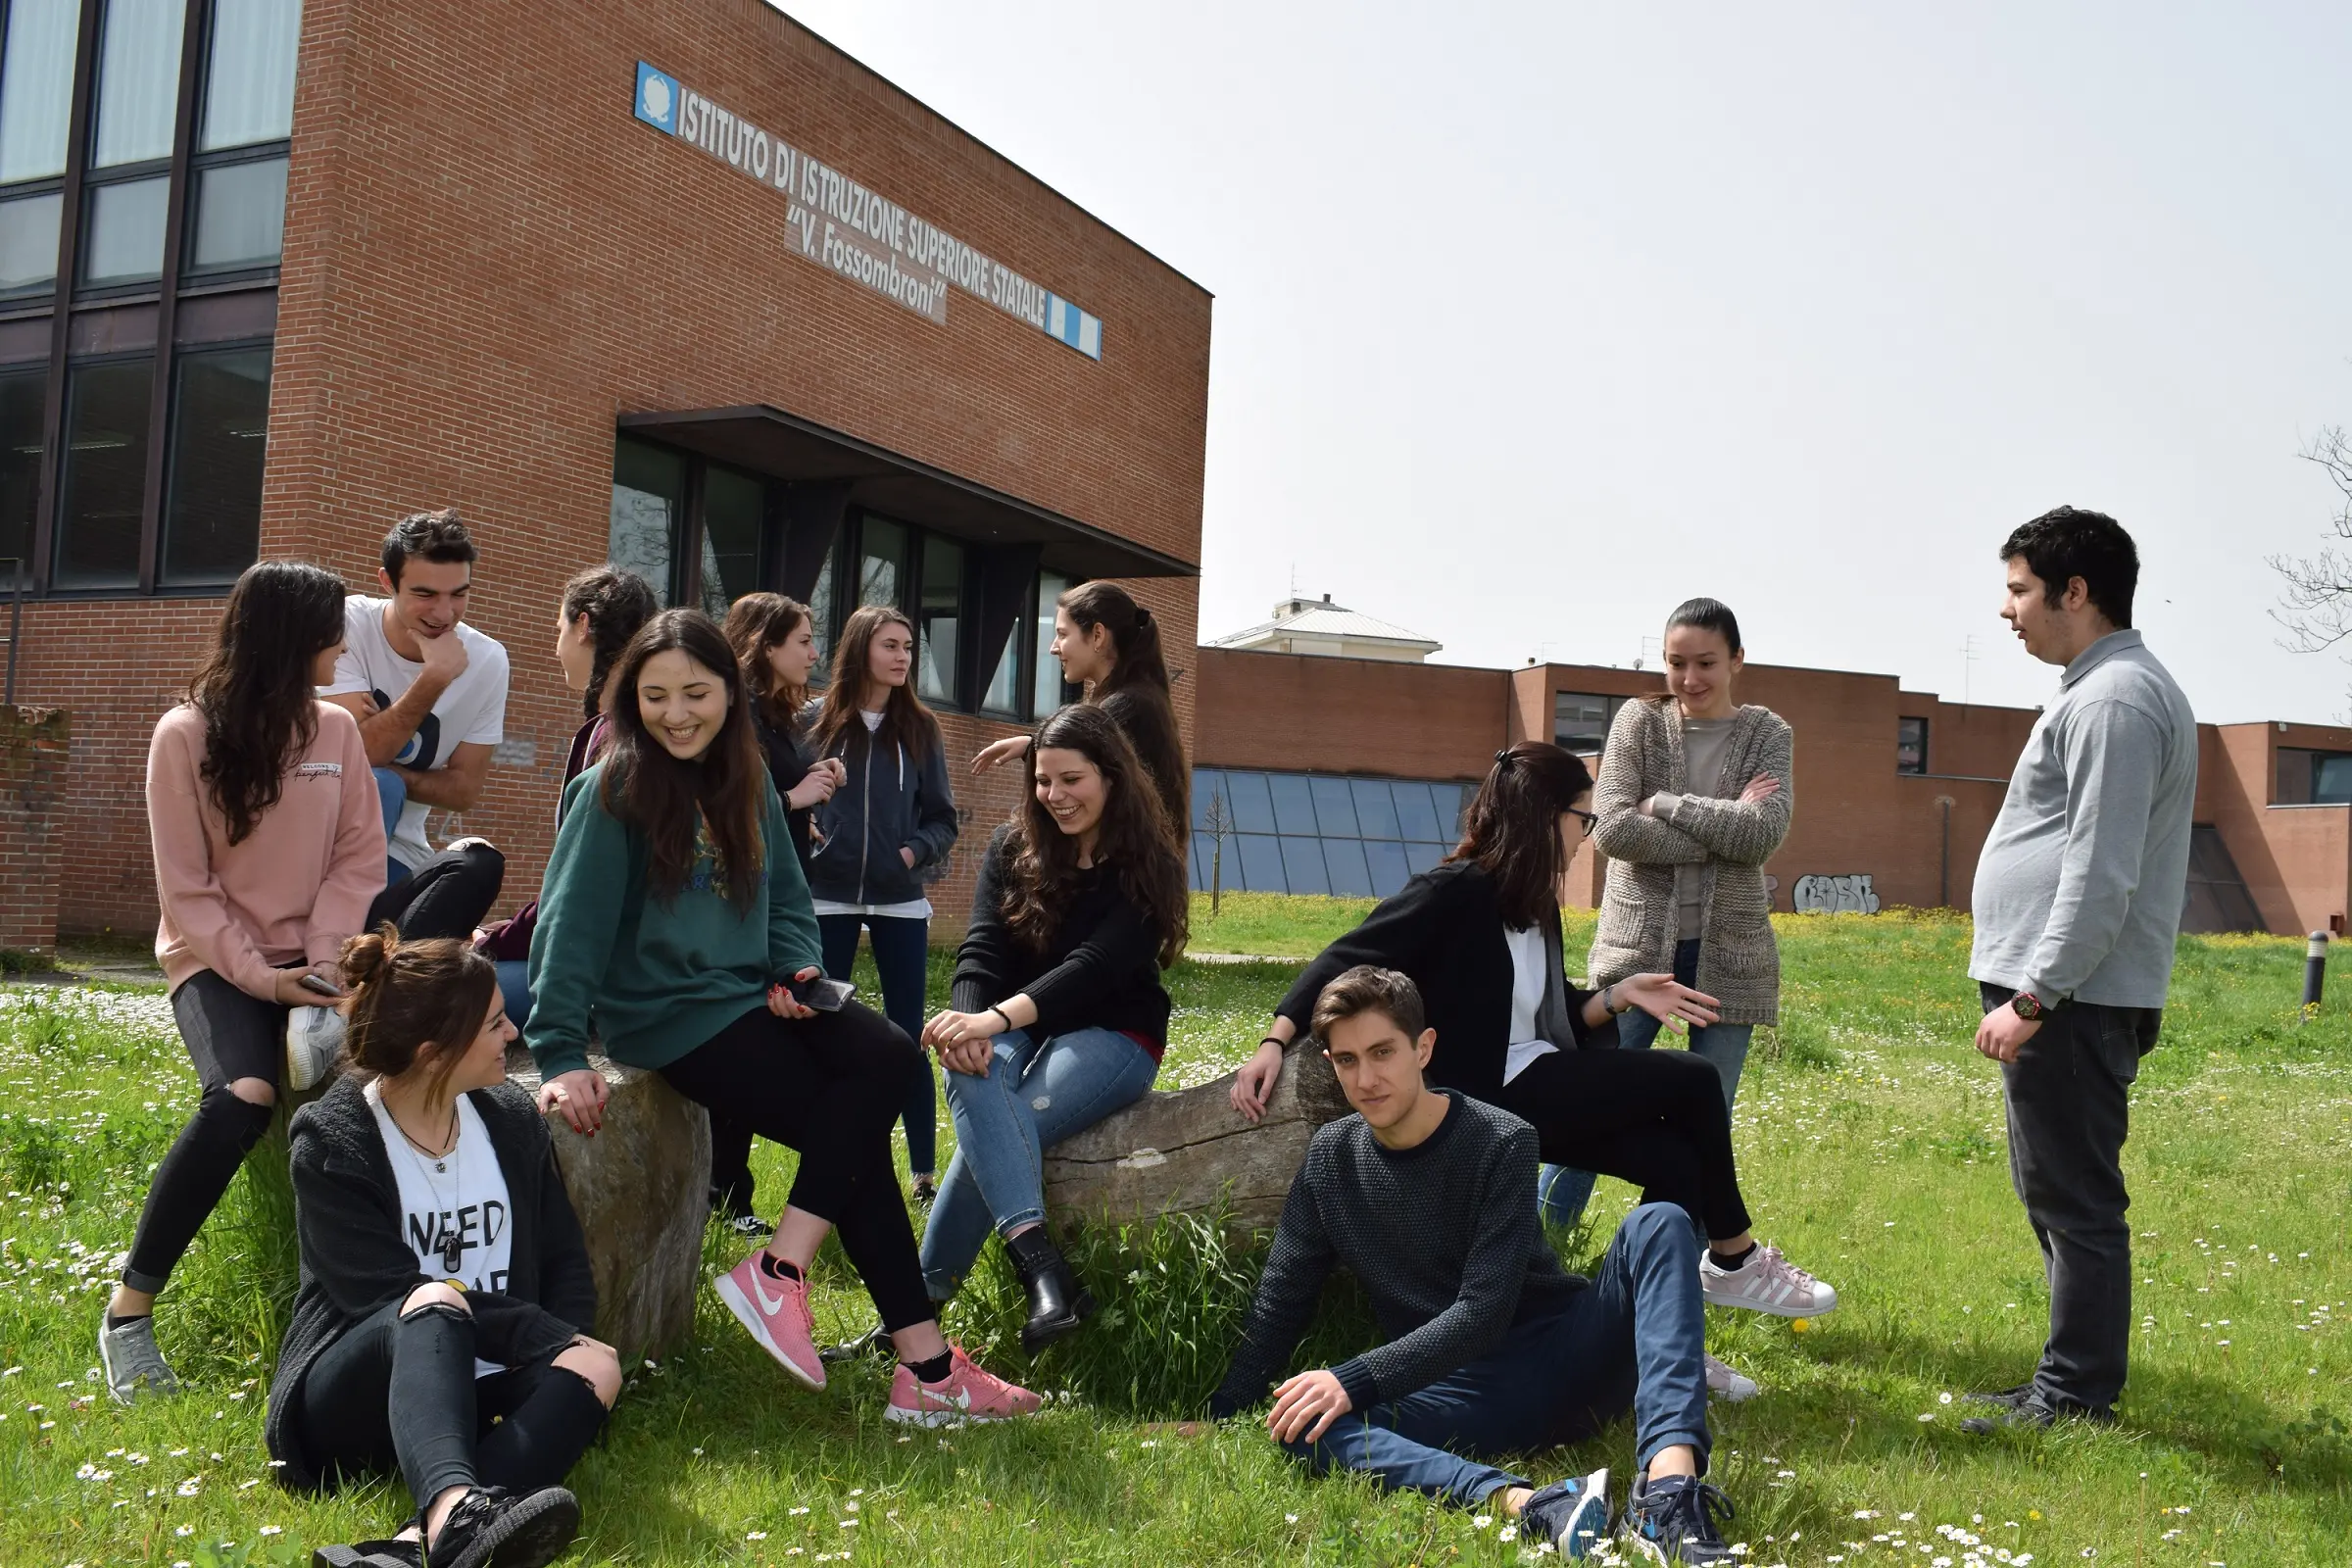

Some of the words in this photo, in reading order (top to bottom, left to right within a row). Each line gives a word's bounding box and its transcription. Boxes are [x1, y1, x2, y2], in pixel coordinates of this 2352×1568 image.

[678, 87, 769, 179] ISTITUTO
[774, 140, 796, 194] DI
[801, 156, 905, 253] ISTRUZIONE
[907, 216, 989, 299] SUPERIORE
[992, 263, 1046, 328] STATALE
[409, 1200, 505, 1256] NEED
